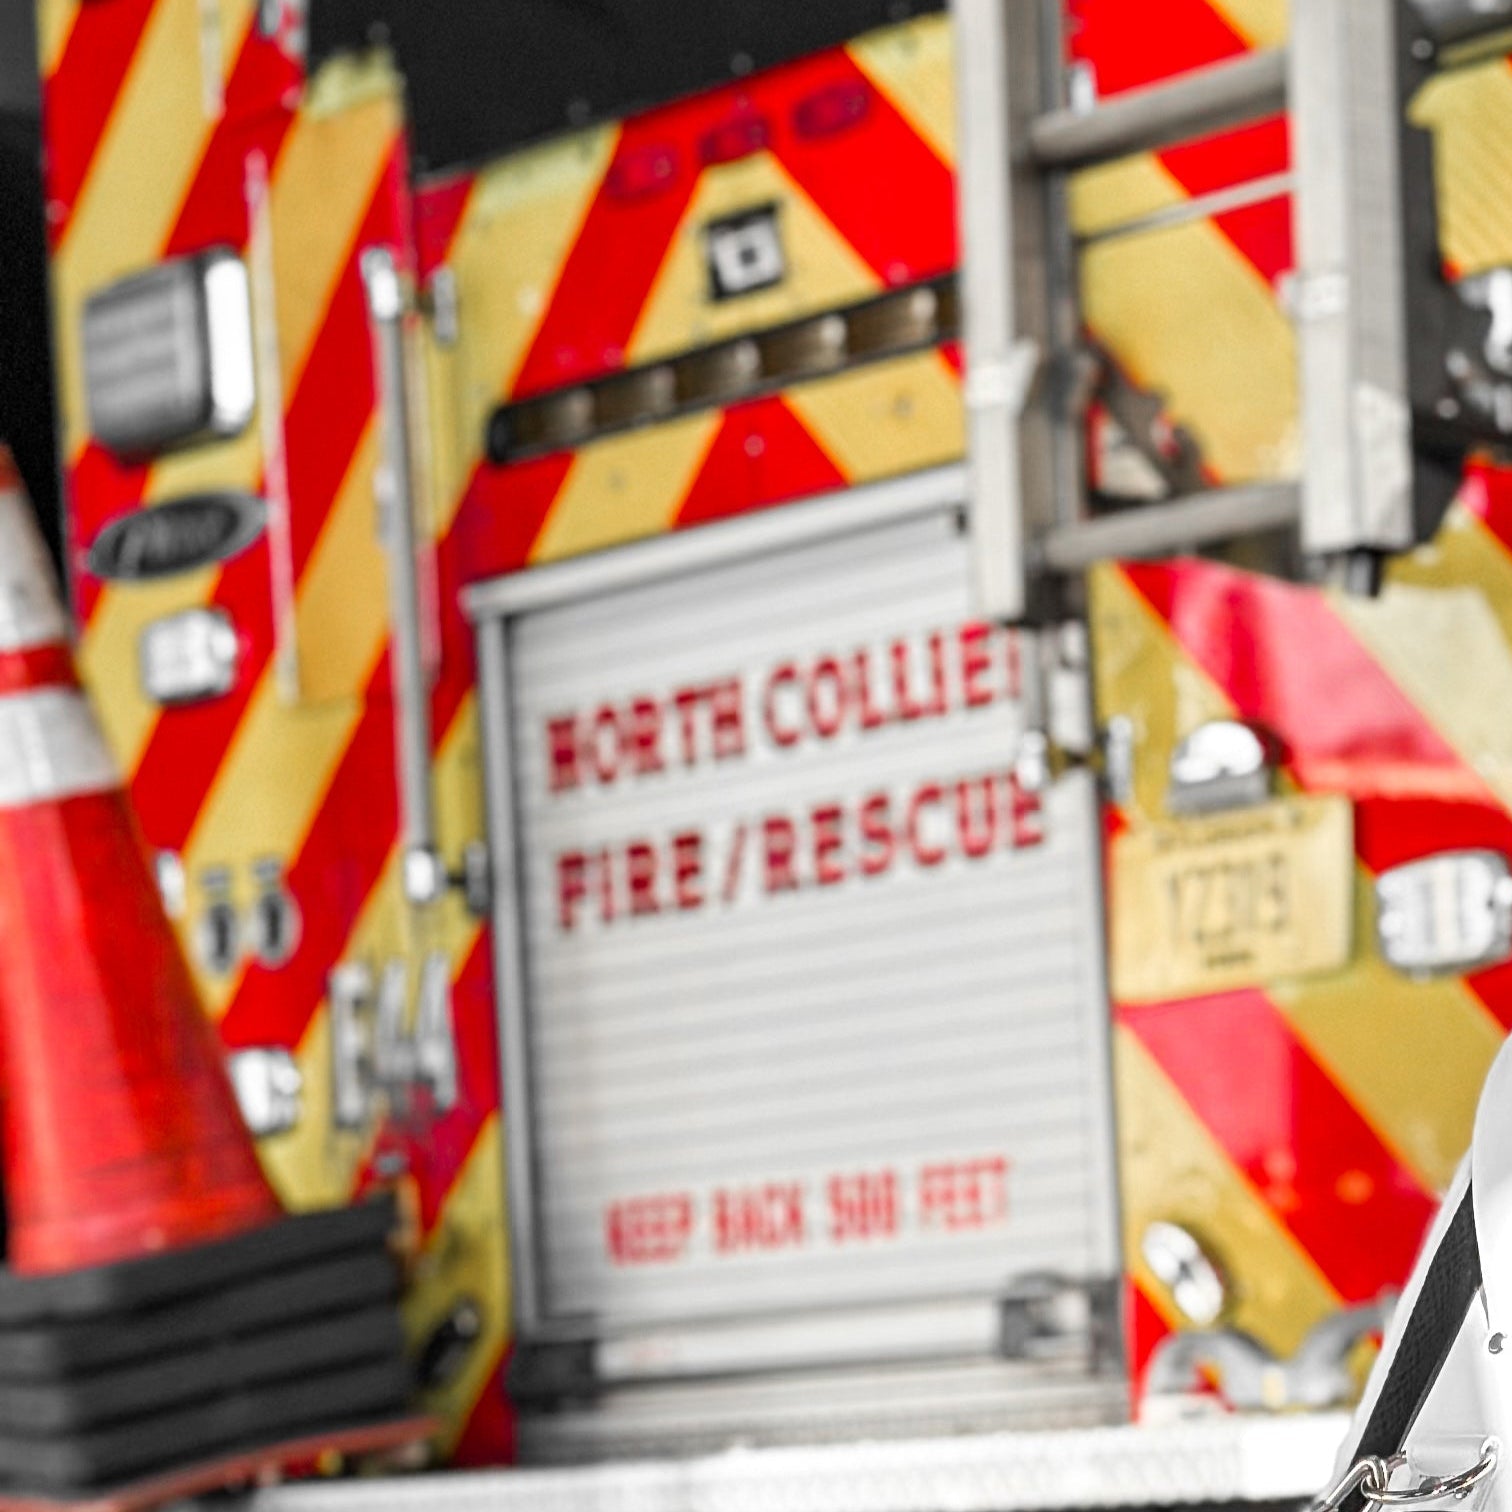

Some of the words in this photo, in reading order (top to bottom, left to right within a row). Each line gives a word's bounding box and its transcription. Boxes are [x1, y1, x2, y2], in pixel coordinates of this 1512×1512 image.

[547, 676, 746, 795] NORTH
[763, 621, 1022, 748] COLLIE
[556, 766, 1046, 932] FIRE/RESCUE
